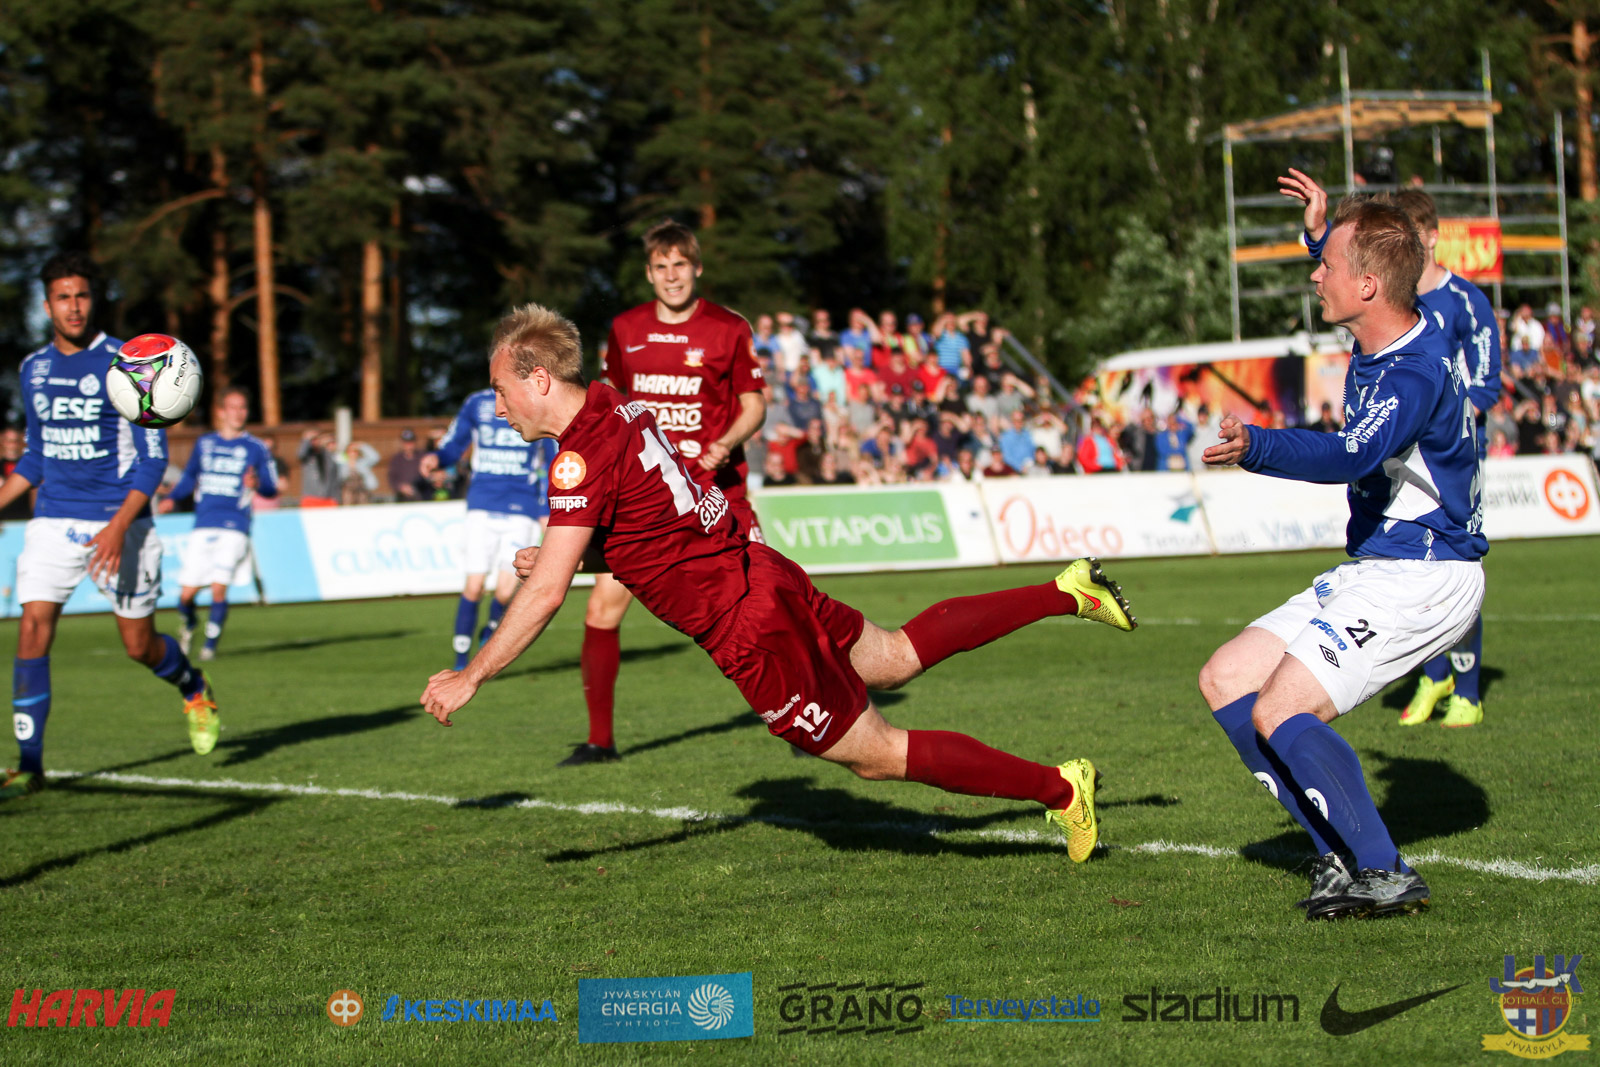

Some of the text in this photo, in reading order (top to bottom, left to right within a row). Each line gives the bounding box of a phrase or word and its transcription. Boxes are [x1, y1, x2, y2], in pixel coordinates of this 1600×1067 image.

[633, 373, 703, 396] HARVIA
[52, 396, 104, 422] ESE
[700, 486, 725, 527] GRANO
[771, 511, 944, 549] VITAPOLIS
[998, 492, 1124, 558] Odeco
[1344, 618, 1378, 649] 21
[792, 702, 830, 733] 12
